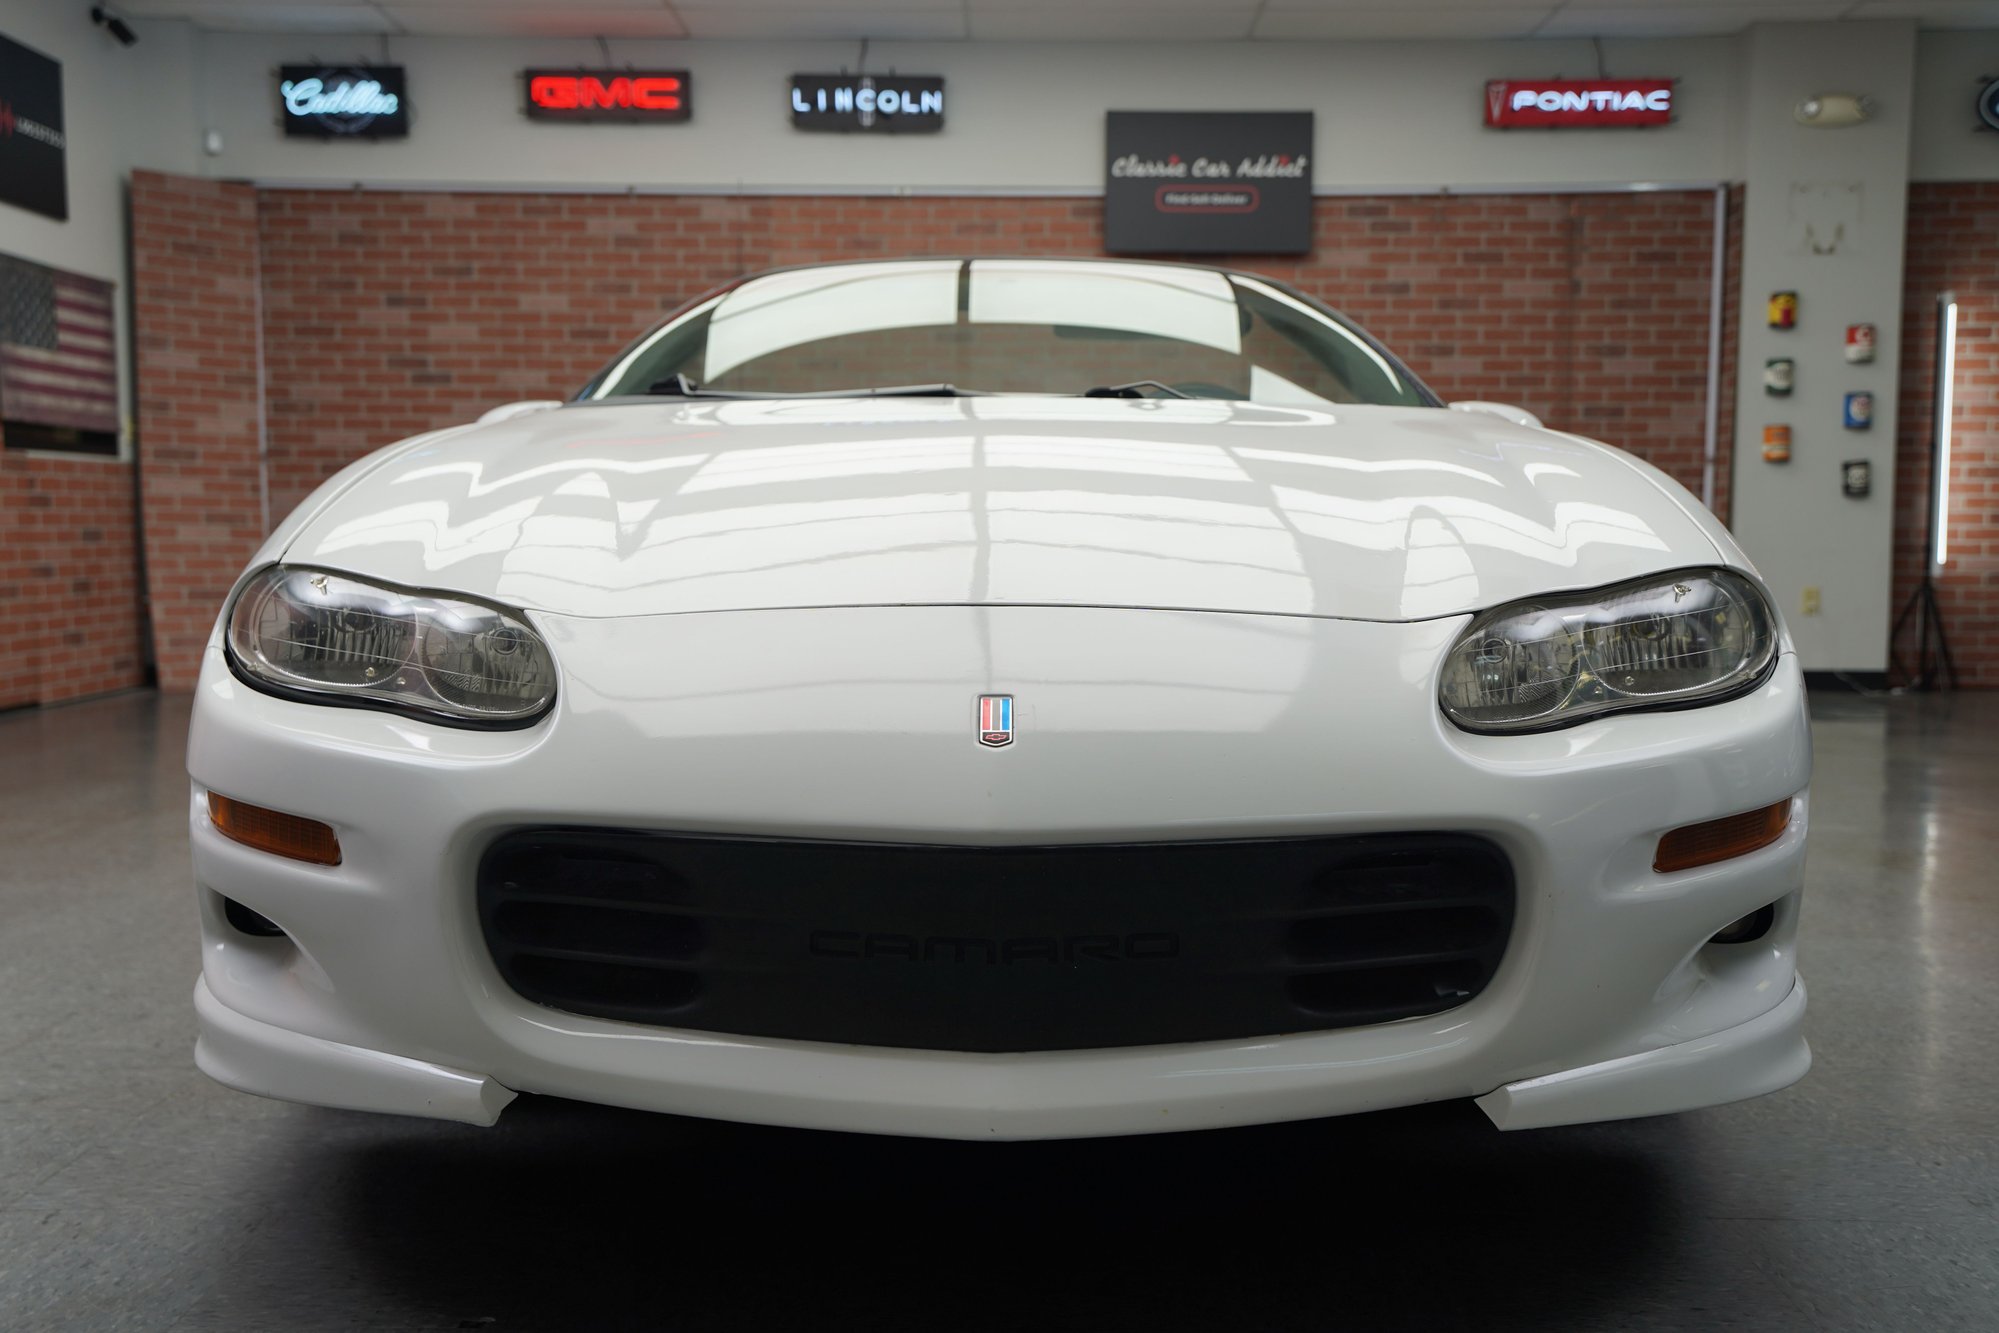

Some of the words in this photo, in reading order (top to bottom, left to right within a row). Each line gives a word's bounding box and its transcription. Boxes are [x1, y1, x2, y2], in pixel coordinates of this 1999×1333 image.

[281, 78, 398, 115] Cadillac
[530, 76, 681, 109] GMC
[792, 87, 942, 114] LINCOLN
[1512, 89, 1671, 112] PONTIAC
[1111, 153, 1188, 178] Classic
[1191, 156, 1232, 178] Car
[1235, 153, 1308, 178] Addict
[809, 929, 1181, 965] CAMARO
